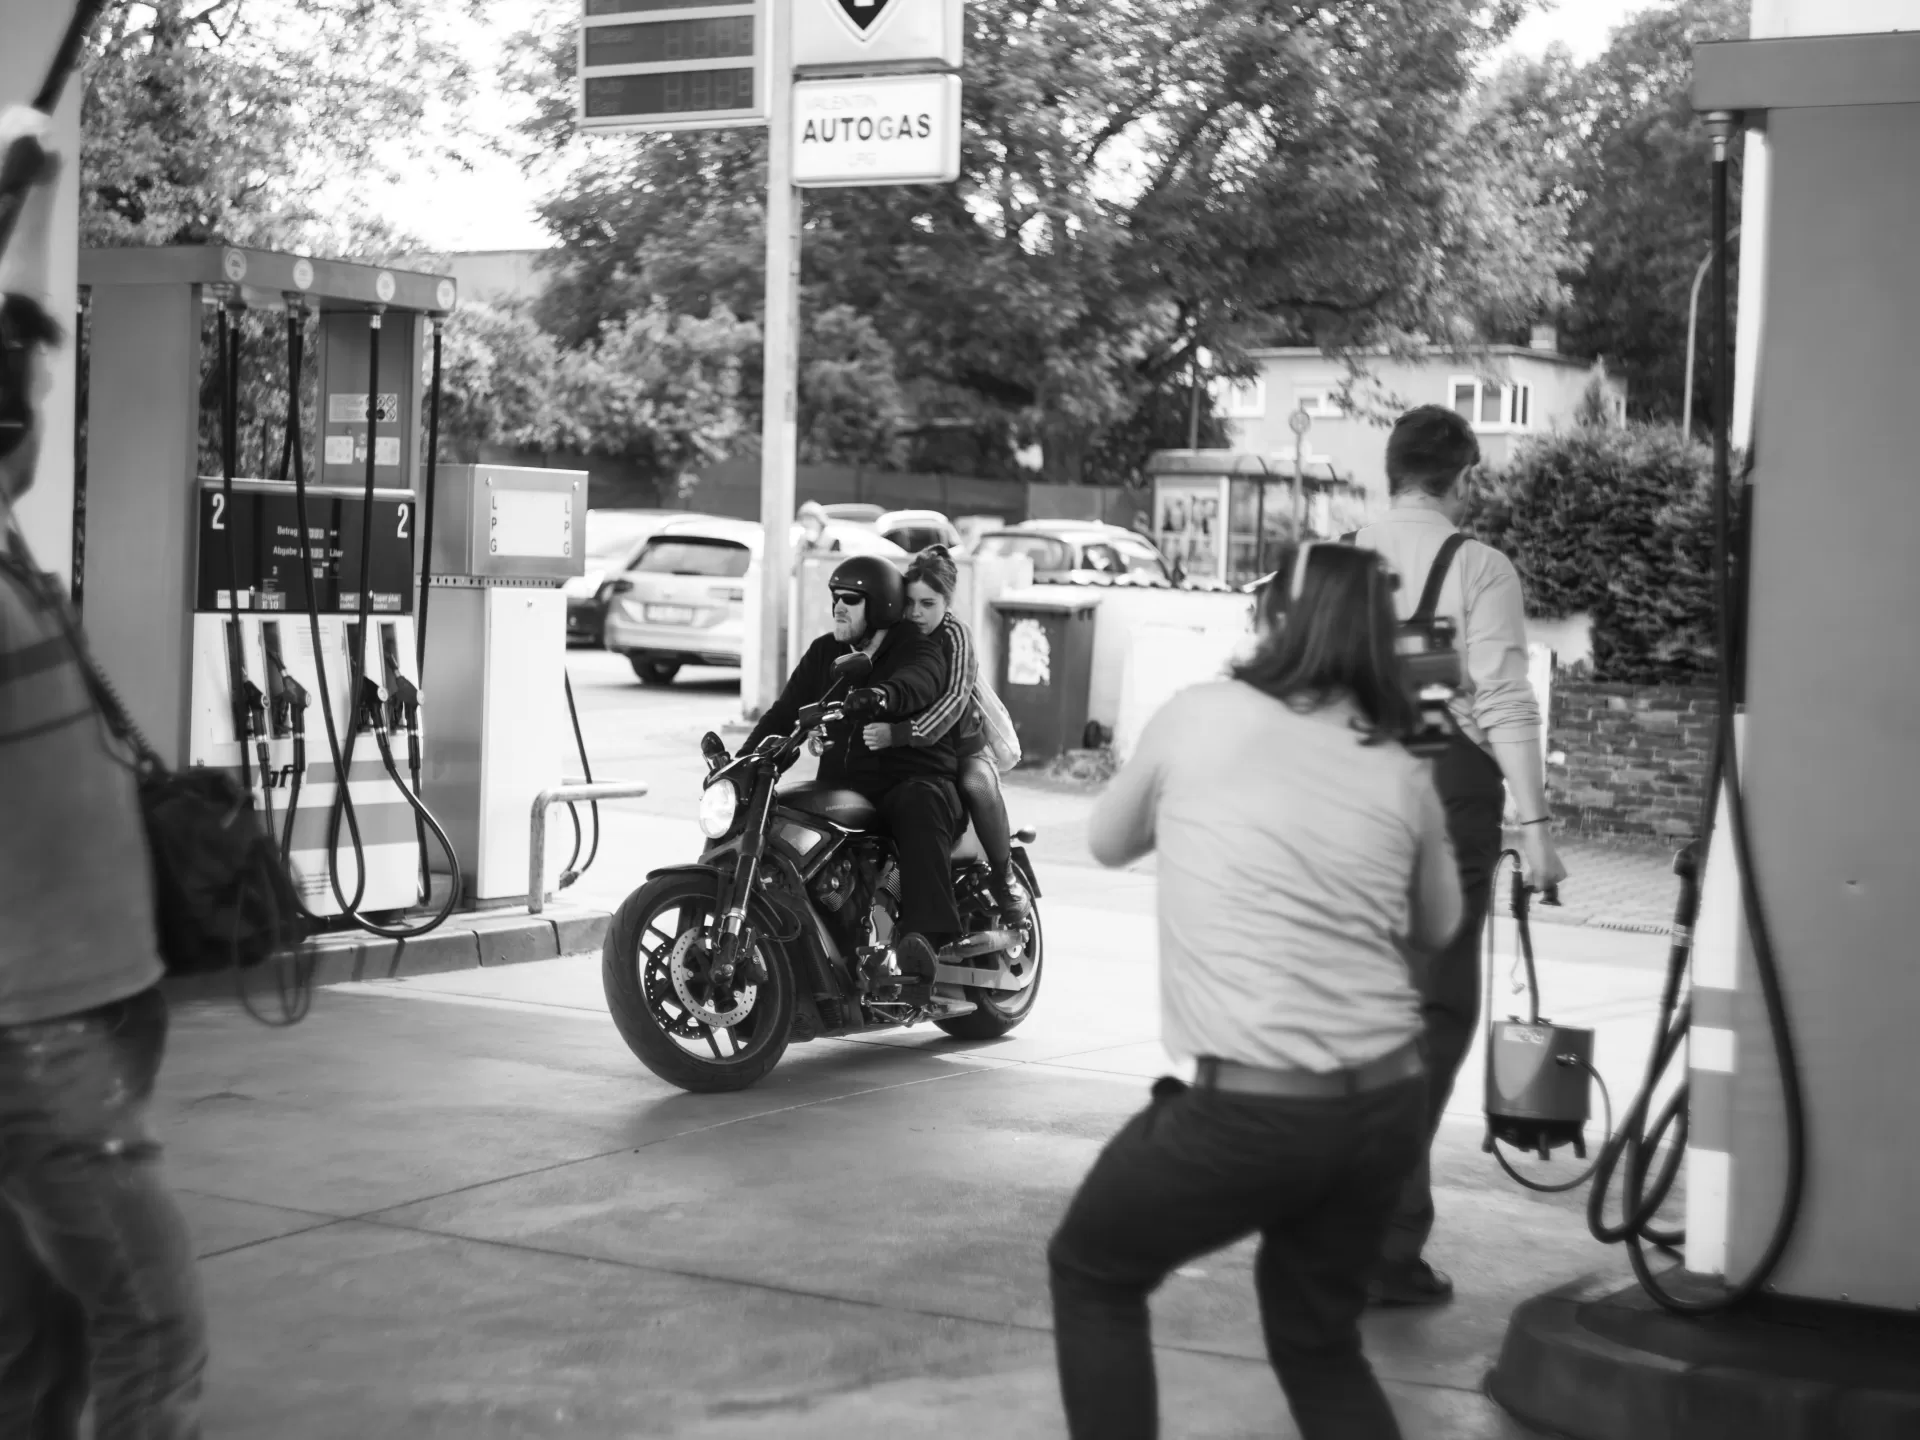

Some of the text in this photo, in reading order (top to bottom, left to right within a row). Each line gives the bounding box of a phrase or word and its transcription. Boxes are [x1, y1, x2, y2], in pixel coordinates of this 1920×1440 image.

[802, 113, 931, 144] AUTOGAS
[212, 493, 225, 530] 2
[397, 503, 409, 539] 2
[277, 526, 298, 538] Betrag
[273, 545, 298, 557] Abgabe
